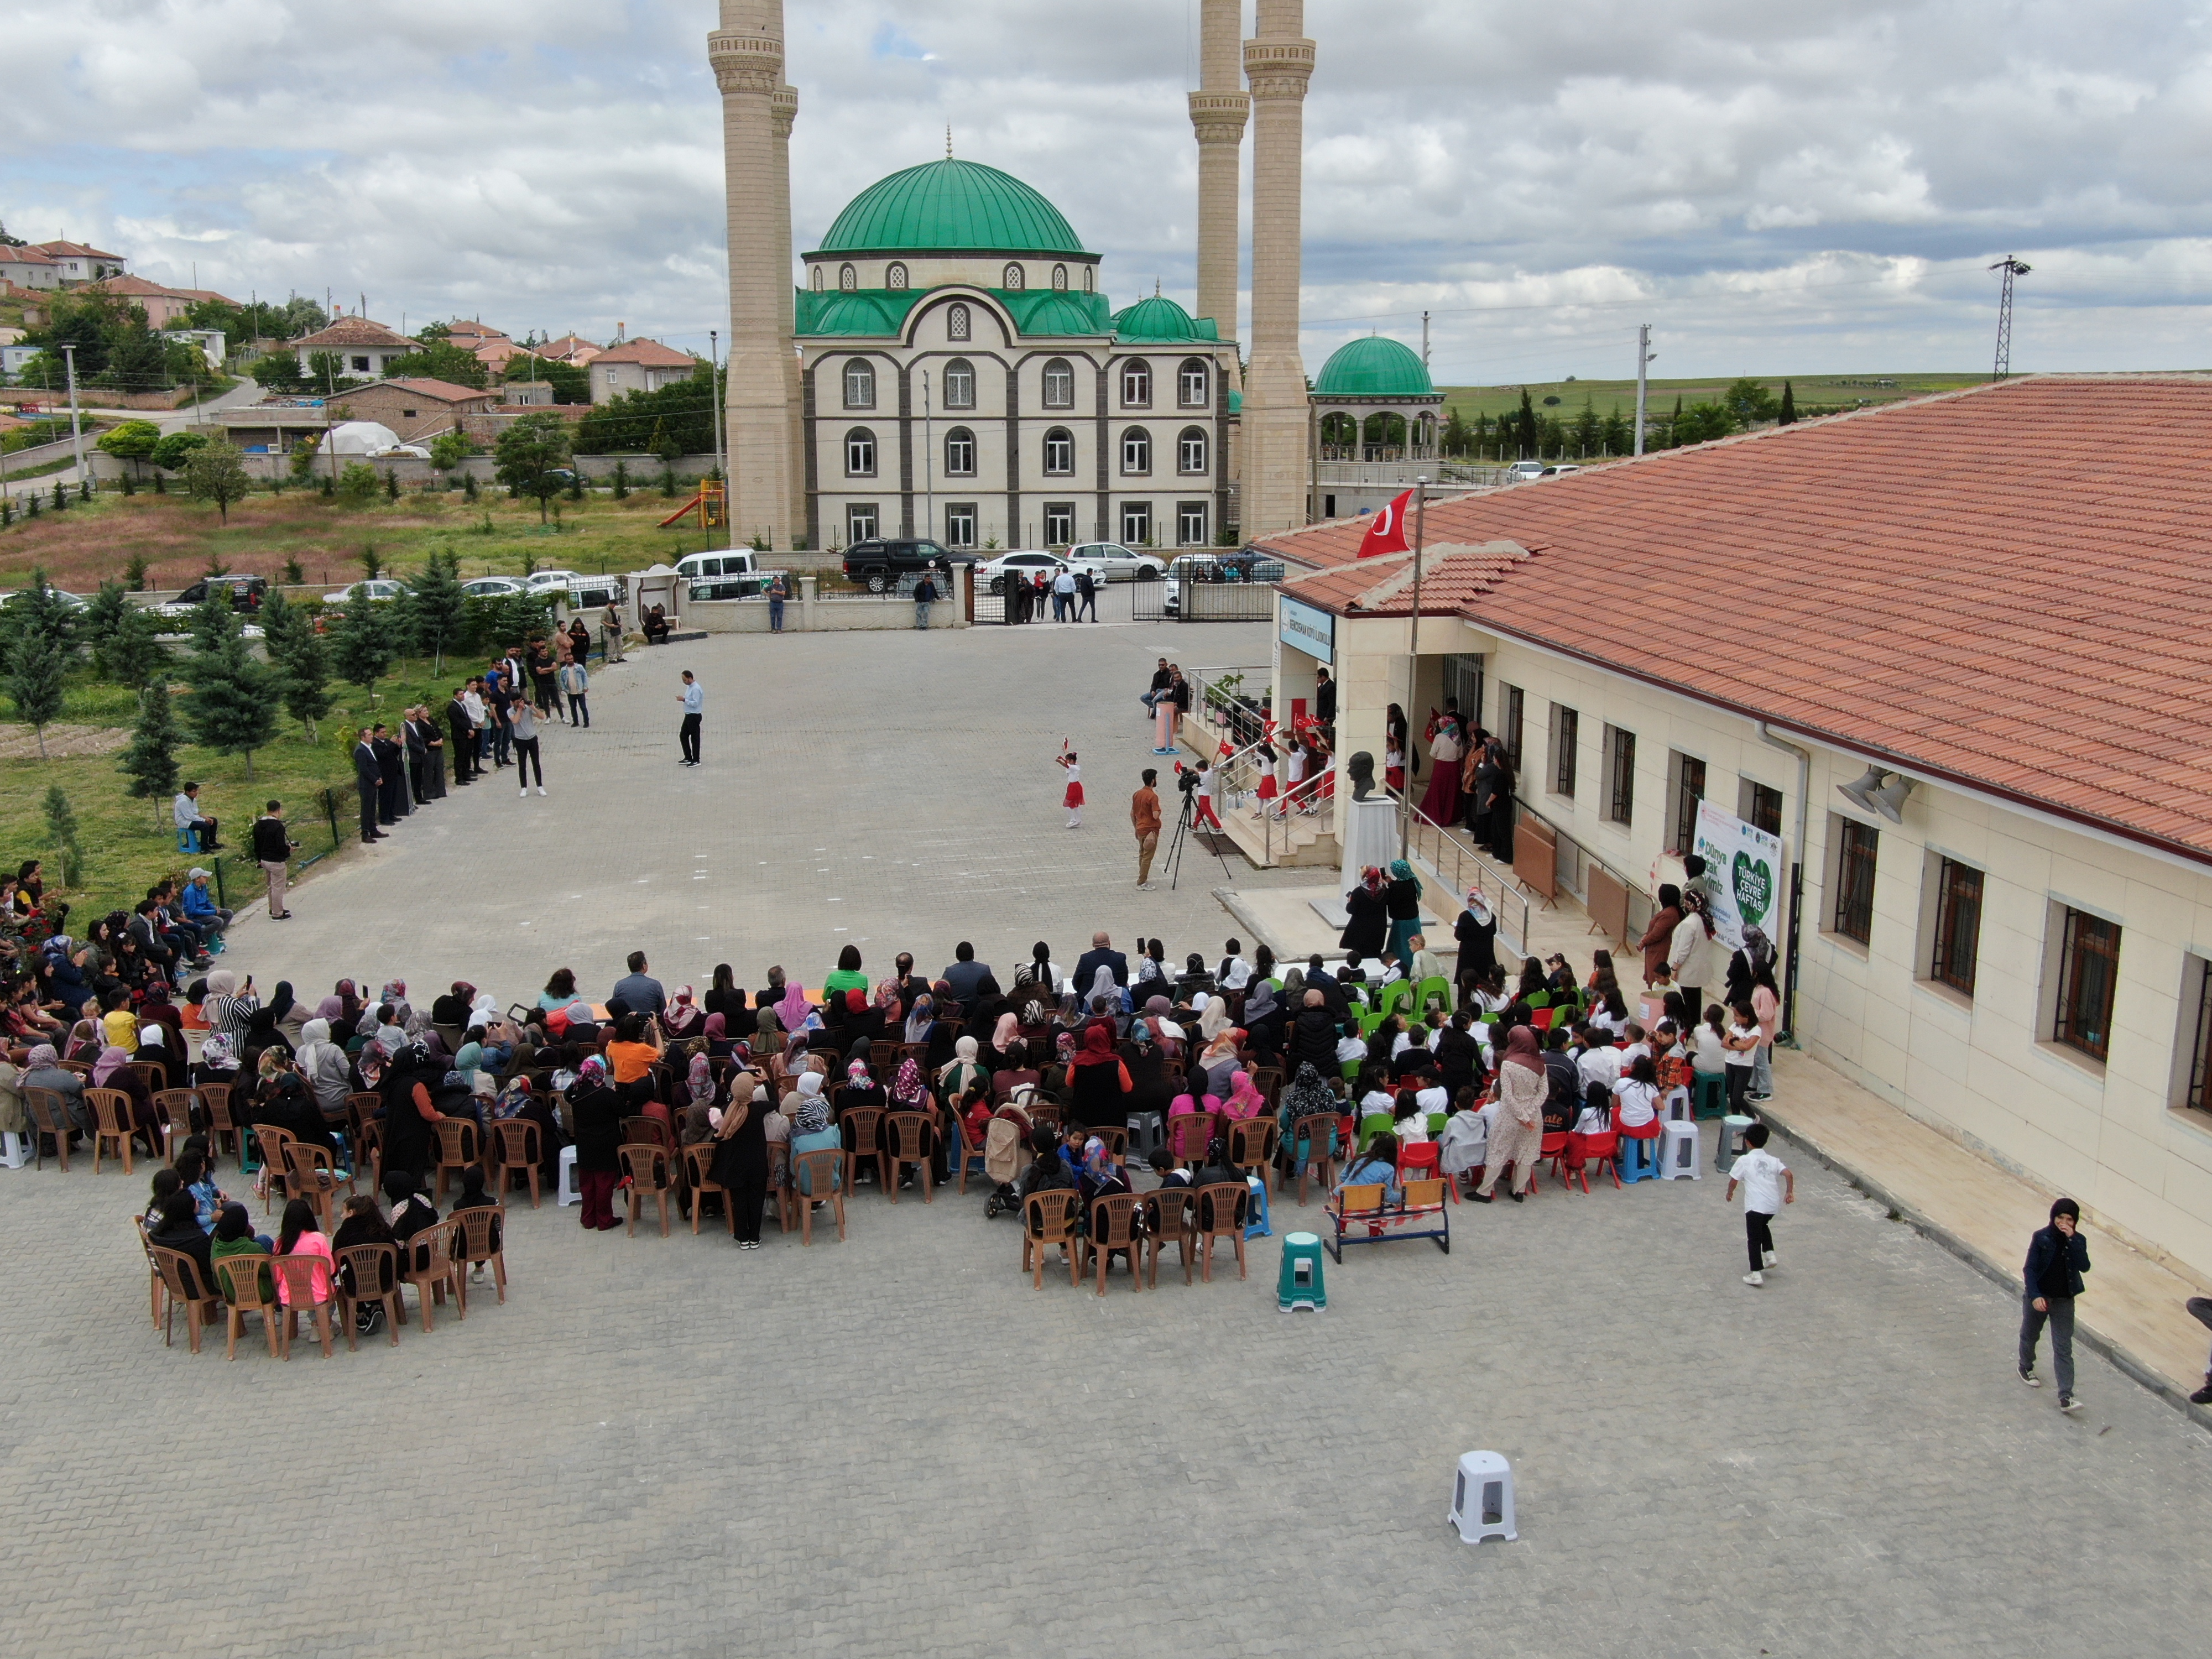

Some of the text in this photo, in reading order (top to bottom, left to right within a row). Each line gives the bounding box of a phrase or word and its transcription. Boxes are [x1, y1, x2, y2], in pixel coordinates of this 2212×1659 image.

[1705, 841, 1727, 865] Dünya
[1703, 872, 1723, 895] vimiz
[1738, 865, 1766, 890] TÜRKİYE
[1736, 889, 1764, 913] HAFTASI
[1740, 879, 1762, 900] ÇEVRE
[1545, 1114, 1562, 1124] ale
